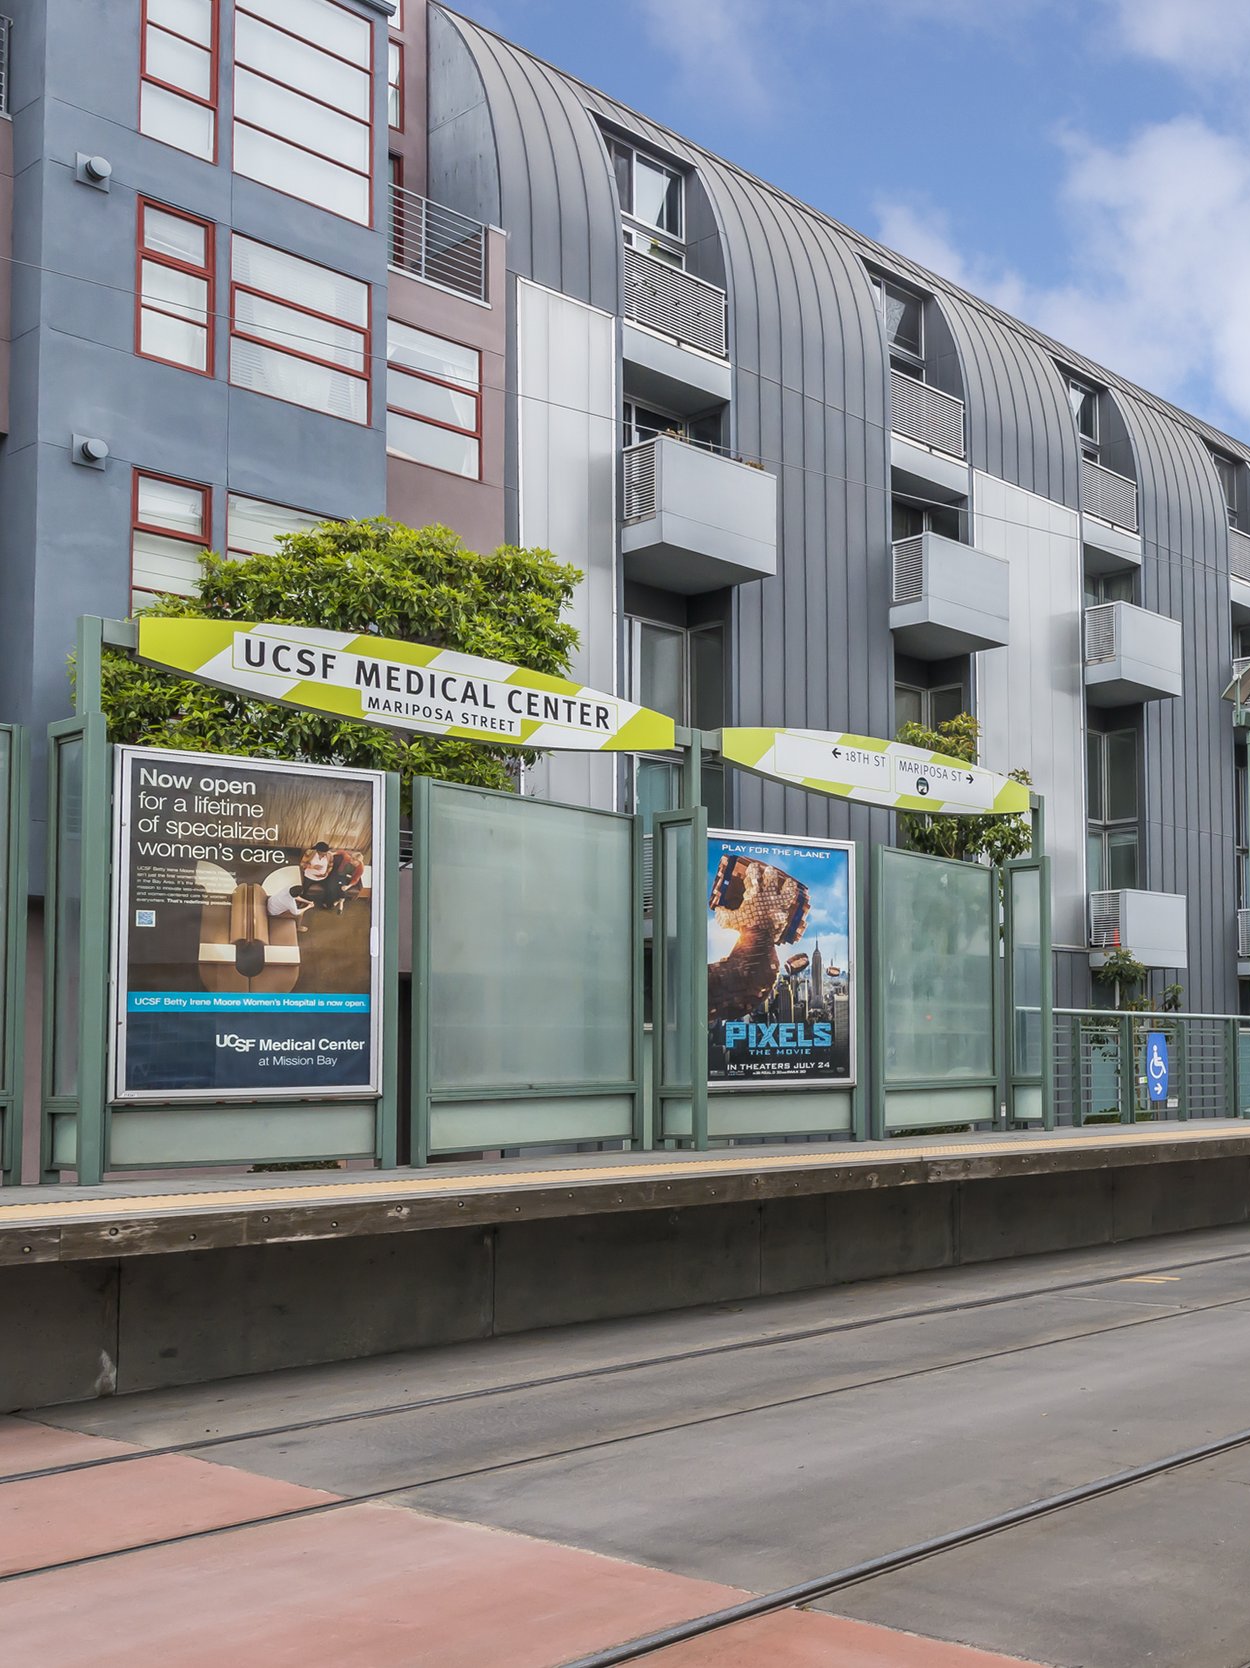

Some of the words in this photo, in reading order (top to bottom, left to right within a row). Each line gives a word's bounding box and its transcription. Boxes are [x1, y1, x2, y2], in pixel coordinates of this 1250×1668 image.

[244, 638, 336, 679] UCSF
[355, 660, 496, 709] MEDICAL
[507, 689, 610, 730] CENTER
[367, 696, 454, 722] MARIPOSA
[460, 712, 515, 732] STREET
[846, 751, 870, 765] 18TH
[874, 756, 886, 768] ST
[140, 767, 193, 790] Now
[199, 776, 256, 796] open
[899, 760, 949, 780] MARIPOSA
[951, 771, 962, 782] ST
[138, 791, 167, 810] for
[174, 798, 188, 812] a
[194, 795, 264, 818] lifetime
[138, 815, 160, 833] of
[166, 820, 279, 841] specialized
[137, 841, 234, 861] women's
[240, 848, 289, 864] care.
[721, 844, 746, 853] PLAY
[749, 846, 769, 854] FOR
[771, 847, 791, 856] THE
[793, 849, 831, 859] PLANET
[134, 997, 161, 1006] UCSF
[163, 998, 187, 1007] Betty
[189, 998, 211, 1006] Irene
[213, 998, 241, 1006] Moore
[242, 998, 281, 1007] Women's
[282, 999, 316, 1008] Hospital
[318, 999, 325, 1007] is
[345, 1000, 366, 1008] open.
[215, 1034, 256, 1052] UCSF
[259, 1038, 315, 1051] Medical
[318, 1038, 365, 1051] Center
[725, 1021, 832, 1048] PIXELS
[258, 1057, 269, 1066] at
[272, 1056, 314, 1066] Mission
[316, 1055, 338, 1067] Bay
[776, 1048, 812, 1056] MOVIE
[726, 1063, 738, 1071] IN
[740, 1062, 791, 1071] THEATERS
[793, 1062, 815, 1070] JULY
[817, 1061, 831, 1069] 24
